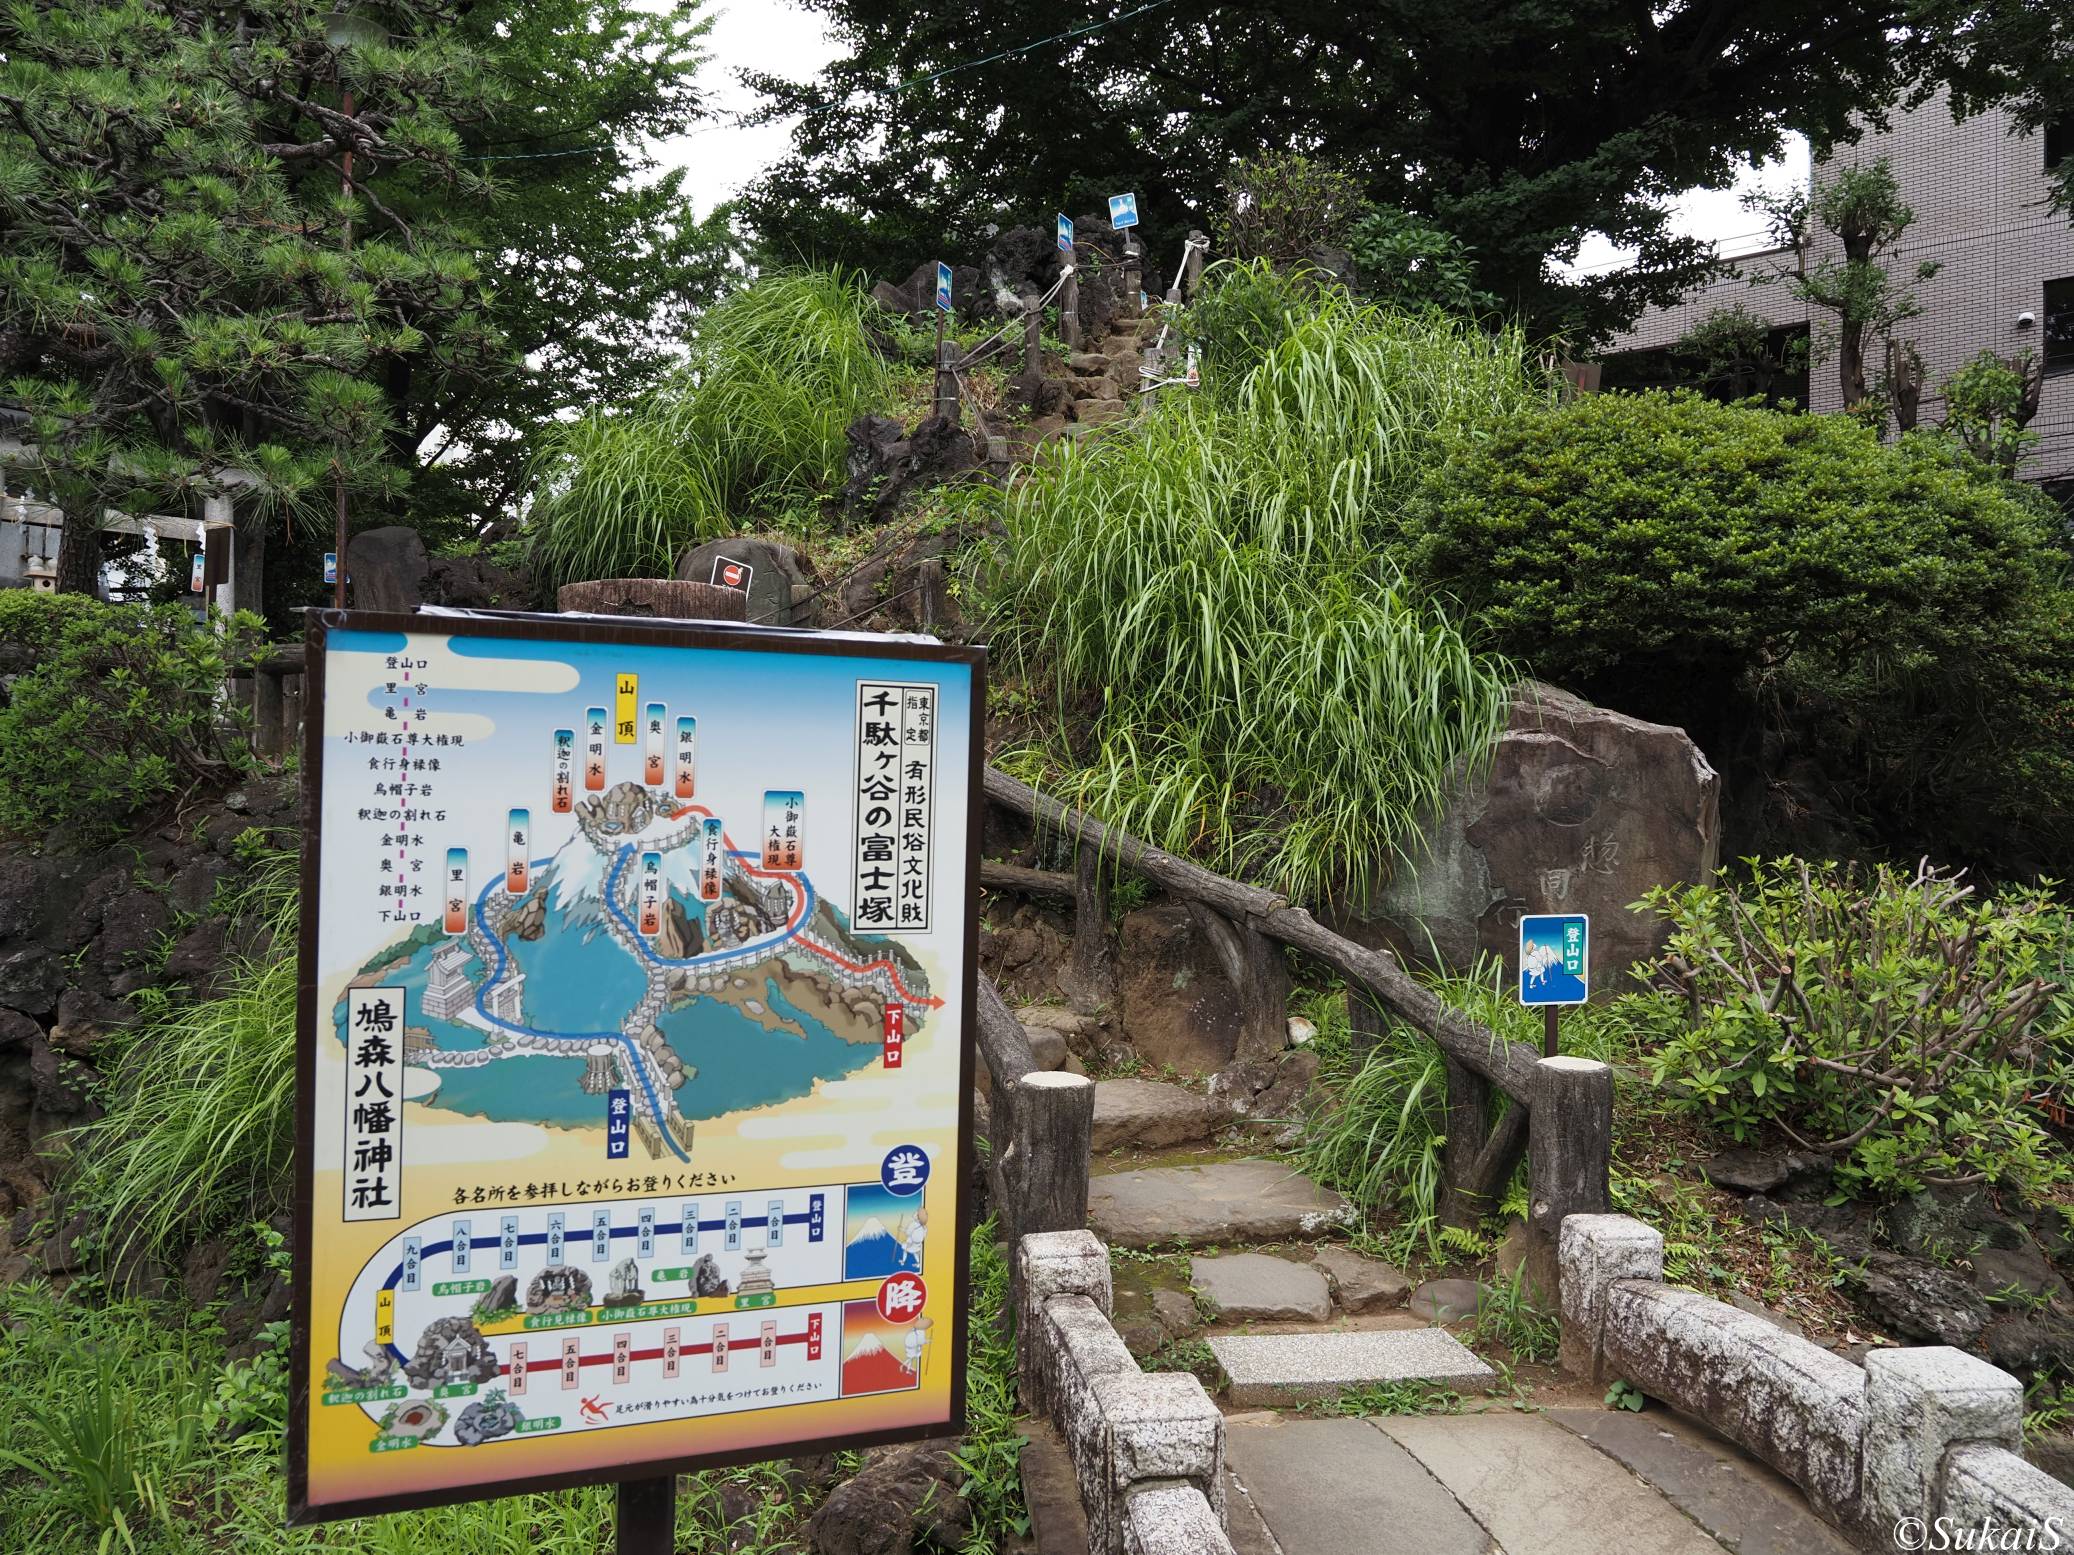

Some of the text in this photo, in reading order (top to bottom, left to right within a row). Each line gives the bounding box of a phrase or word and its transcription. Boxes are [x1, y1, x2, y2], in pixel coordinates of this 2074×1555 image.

[385, 657, 428, 670] 登山口
[906, 696, 918, 742] 指定
[919, 696, 930, 743] 東京都
[589, 721, 603, 776] 金明水
[648, 720, 662, 769] 奥宮
[679, 731, 693, 784] 銀明水
[556, 735, 571, 808] 釈迦の割れ石
[358, 808, 446, 821] 釈迦の割れ石
[380, 834, 424, 846] 金明水
[511, 830, 526, 876] 亀岩
[768, 825, 781, 866] 大権現
[901, 760, 928, 923] 有形民俗文化財
[379, 884, 423, 896] 銀明水
[378, 910, 421, 922] 下山口
[1566, 928, 1580, 970] 登山口
[886, 1009, 901, 1062] 下山口
[351, 999, 398, 1209] 鳩森八幡神社
[610, 1098, 628, 1154] 登山口
[453, 1171, 736, 1204] 各名所を参拝しながらお登りください
[888, 1152, 925, 1187] 登
[596, 1217, 607, 1254] 五合目
[640, 1215, 652, 1250] 四合目
[684, 1210, 696, 1247] 三合目
[728, 1208, 739, 1243] 二合目
[770, 1206, 781, 1240] 一合目
[810, 1200, 822, 1236] 登山口
[456, 1228, 468, 1266] 八合目
[504, 1224, 516, 1261] 七合目
[550, 1220, 562, 1258] 六合目
[406, 1244, 418, 1283] 九合目
[886, 1280, 922, 1315] 降
[666, 1335, 678, 1371] 三合目
[715, 1330, 727, 1365] 二合目
[763, 1326, 774, 1360] 一合目
[809, 1319, 820, 1354] 下山口
[513, 1350, 524, 1387] 七合目
[565, 1345, 576, 1382] 五合目
[616, 1340, 628, 1376] 四合目
